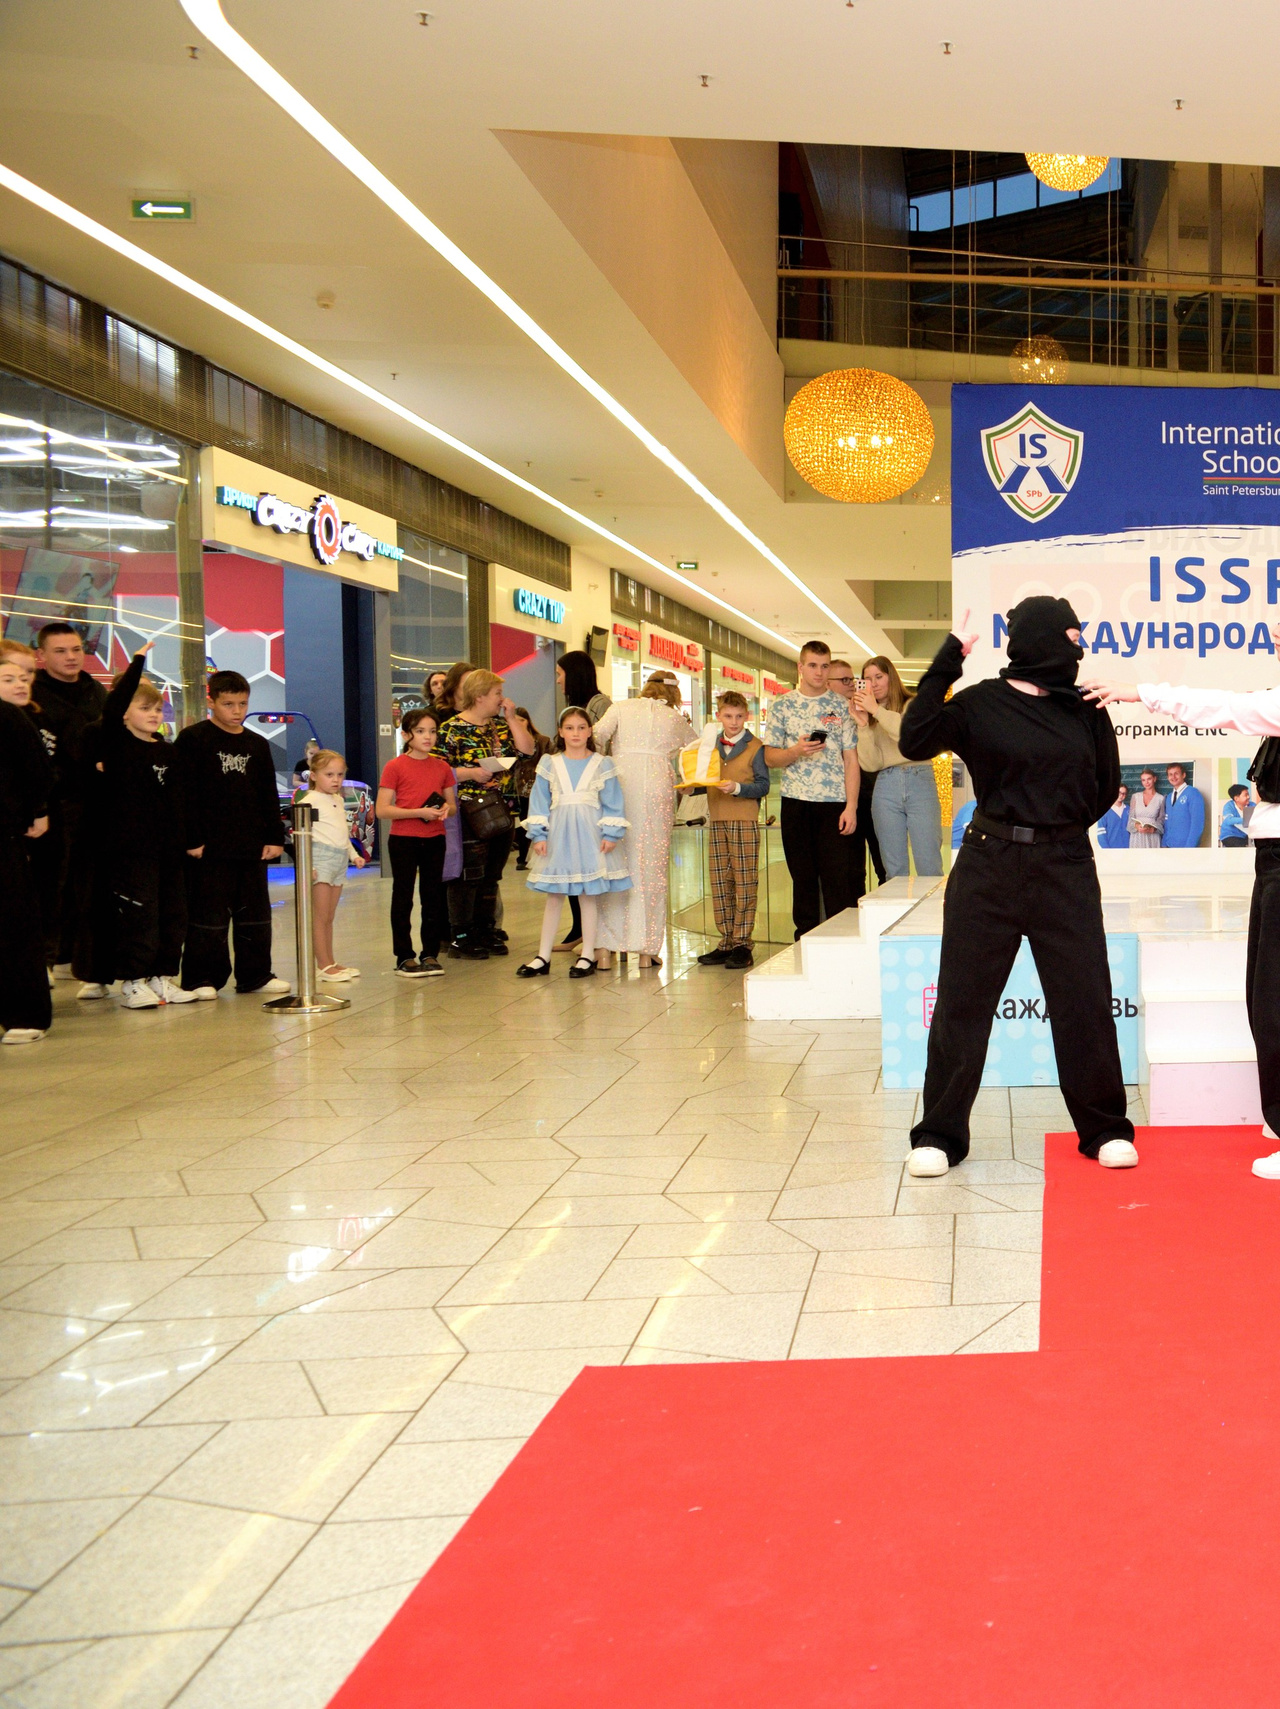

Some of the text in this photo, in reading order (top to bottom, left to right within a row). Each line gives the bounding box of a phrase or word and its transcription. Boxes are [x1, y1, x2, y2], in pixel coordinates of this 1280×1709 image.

[1018, 433, 1048, 459] IS
[1026, 489, 1043, 498] SPb
[1202, 484, 1230, 496] Saint
[518, 587, 549, 619] CRAZY
[1114, 724, 1189, 740] ограмма
